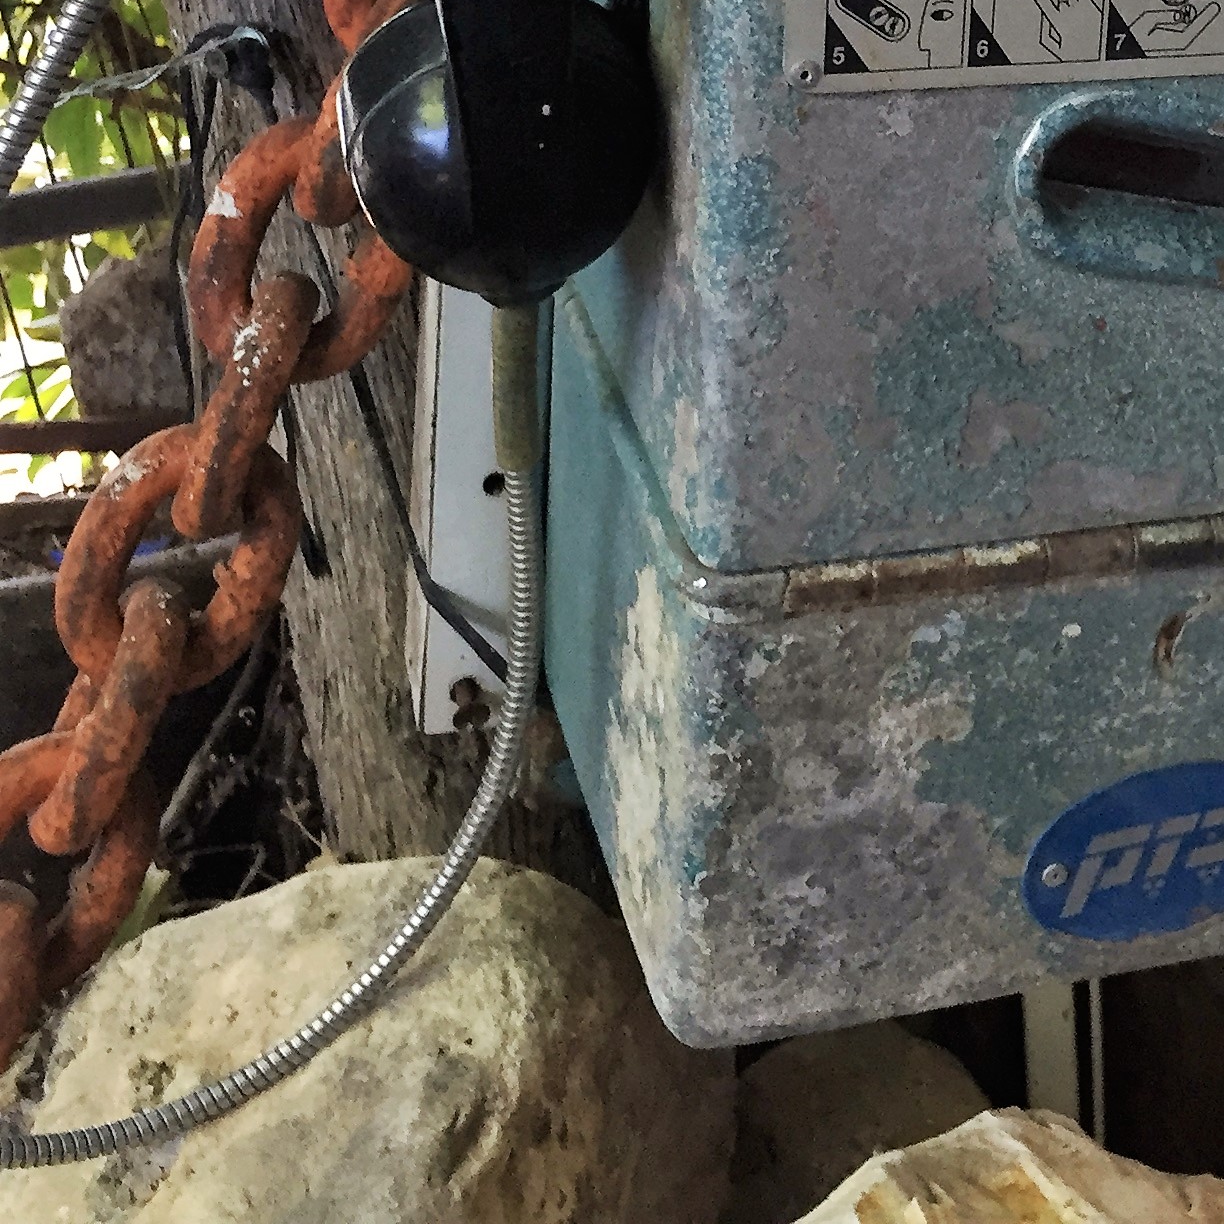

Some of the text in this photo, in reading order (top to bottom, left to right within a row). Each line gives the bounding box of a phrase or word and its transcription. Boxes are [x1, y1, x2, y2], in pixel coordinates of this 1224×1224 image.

[976, 40, 989, 58] 6
[1114, 33, 1127, 51] 7
[832, 47, 845, 66] 5
